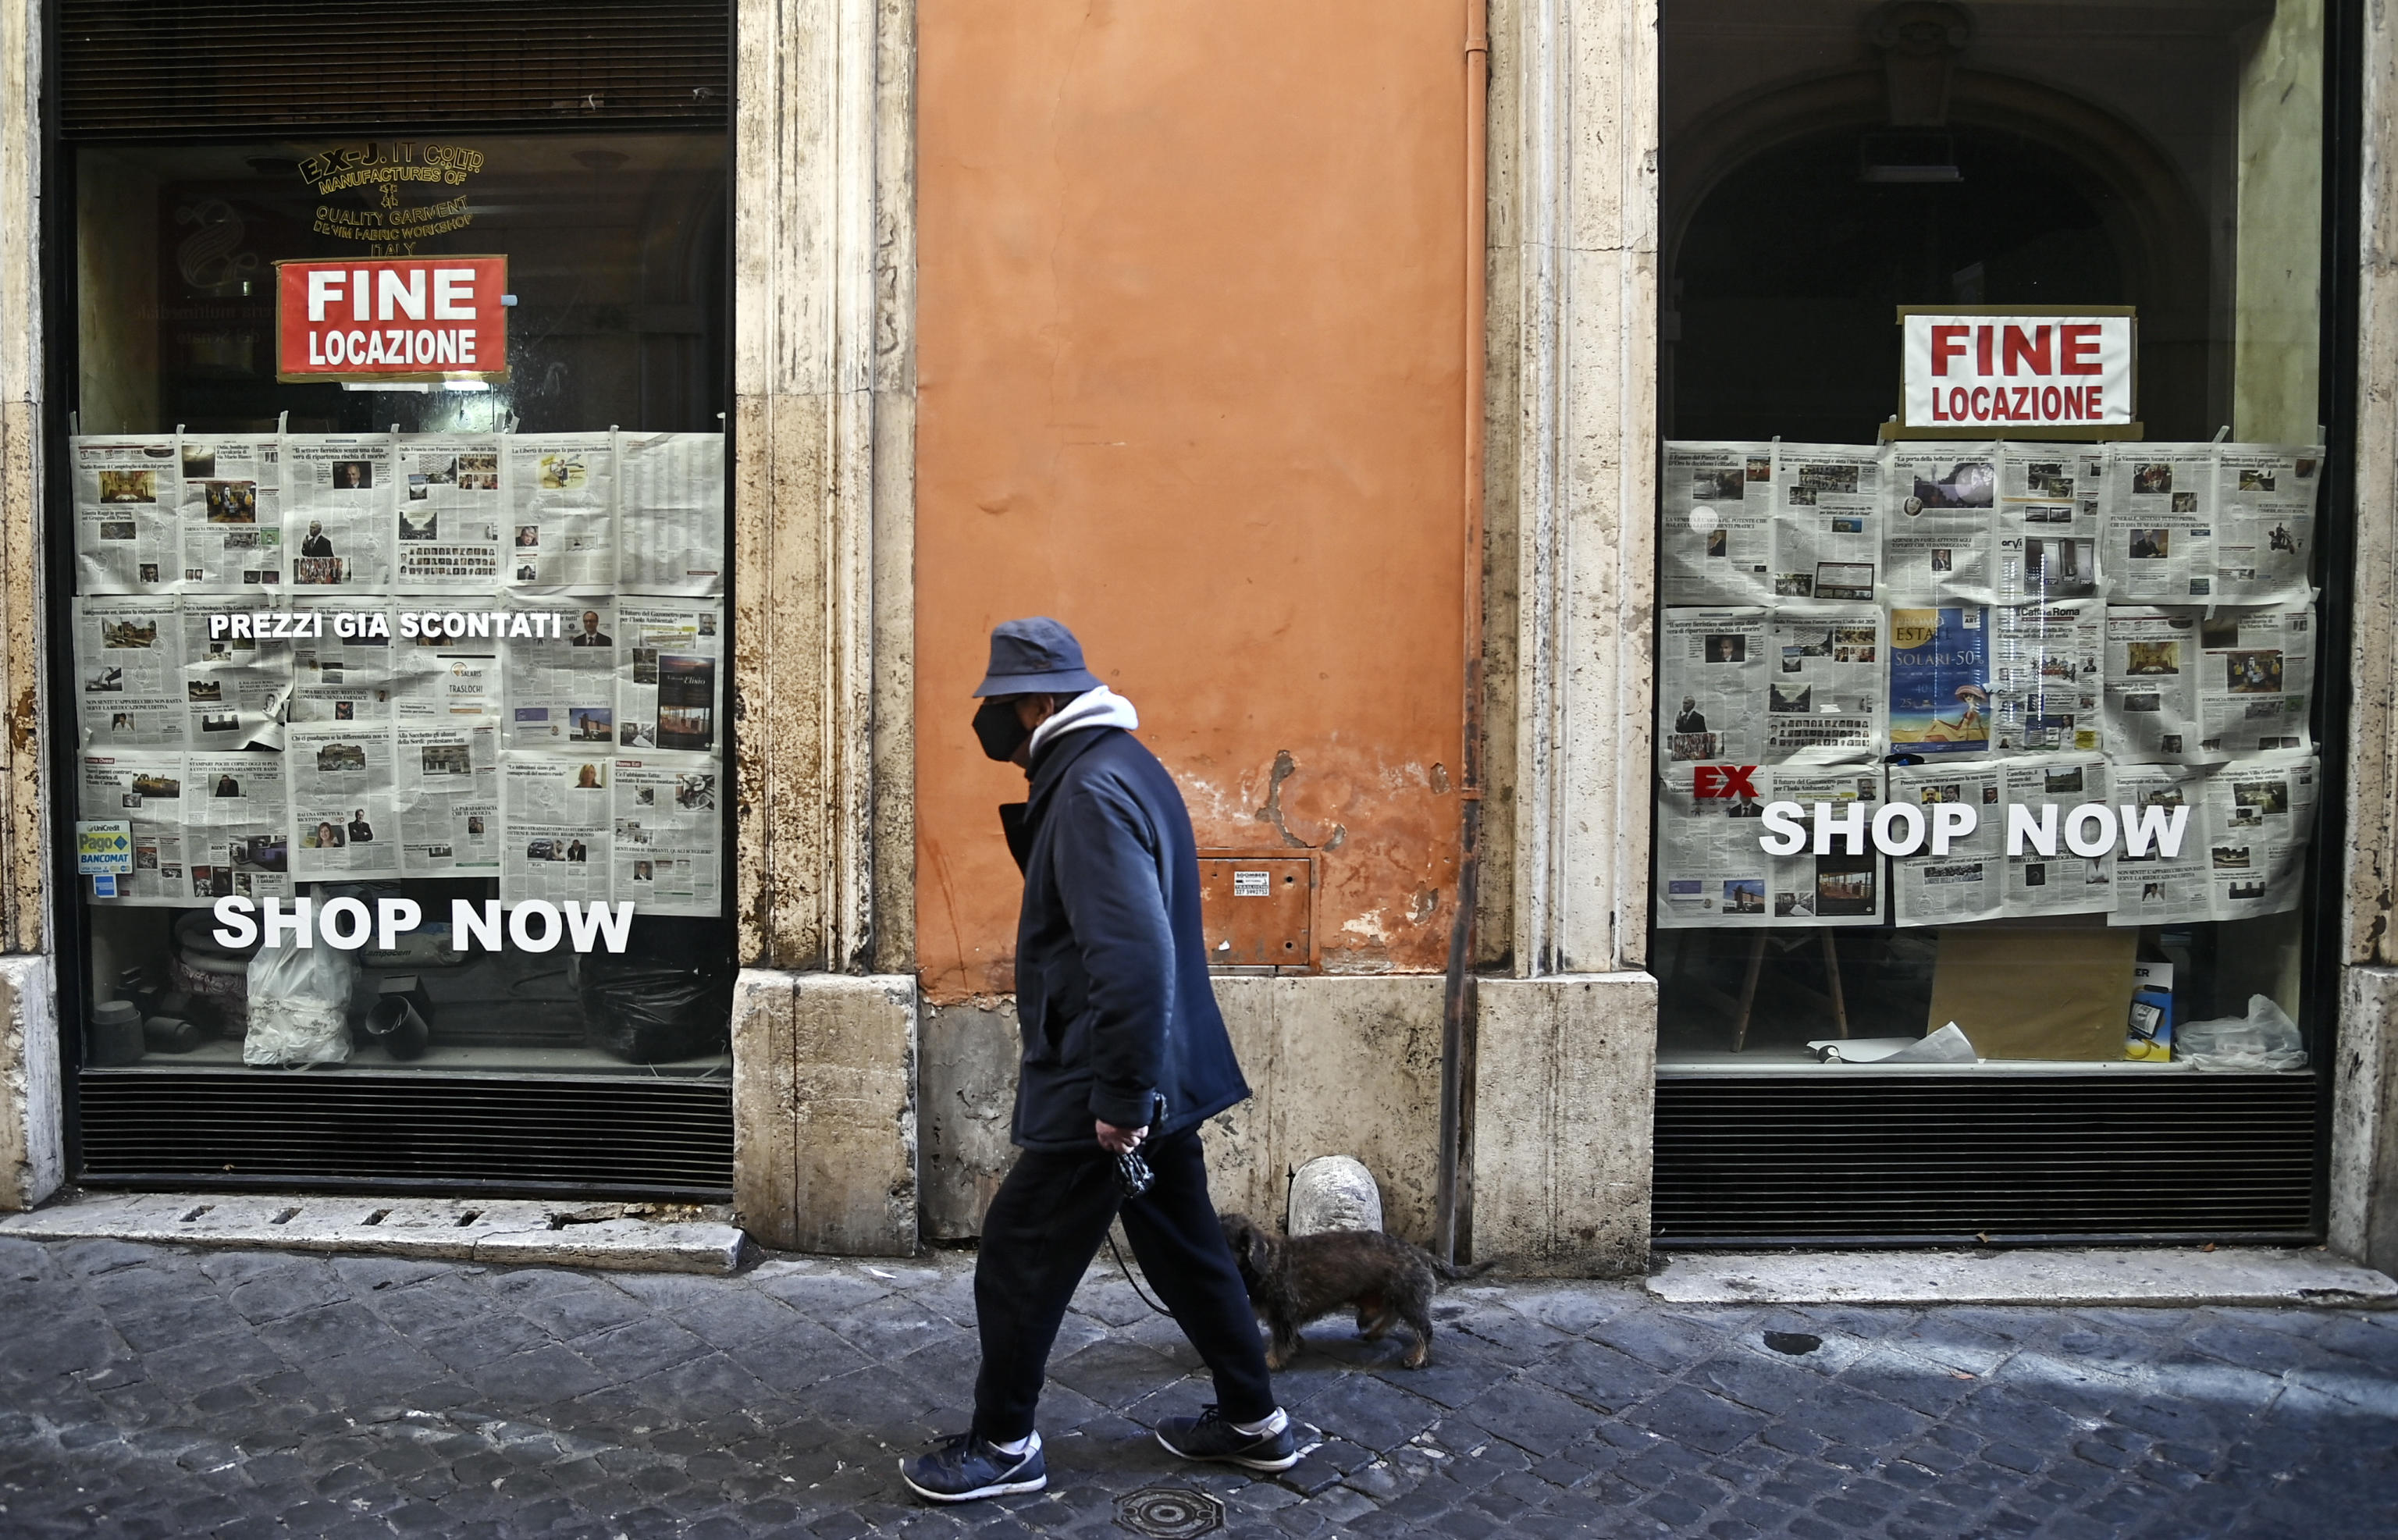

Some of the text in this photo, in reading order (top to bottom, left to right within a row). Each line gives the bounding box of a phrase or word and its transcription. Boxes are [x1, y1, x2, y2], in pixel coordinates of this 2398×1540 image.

[318, 167, 467, 195] MANUFACTURES OF
[316, 194, 468, 226] QUALITY GARMENT
[401, 213, 474, 240] WORKSHOP
[308, 269, 476, 321] FINE
[309, 329, 476, 365] LOCAZIONE
[1931, 325, 2102, 376] FINE
[1933, 386, 2102, 421] LOCAZIONE
[210, 613, 560, 638] PREZZI GIA SCONTATI
[1897, 617, 1944, 627] PROMO
[2053, 607, 2080, 617] Roma
[1896, 627, 1952, 641] ESTATE
[1895, 652, 1949, 666] SOLARI
[449, 685, 483, 693] TRASLOCHI
[1694, 766, 1759, 798] EX
[1759, 801, 2190, 857] SHOP NOW
[79, 834, 113, 852] Pago
[80, 855, 129, 863] BANCOMAT
[213, 895, 635, 953] SHOP NOW
